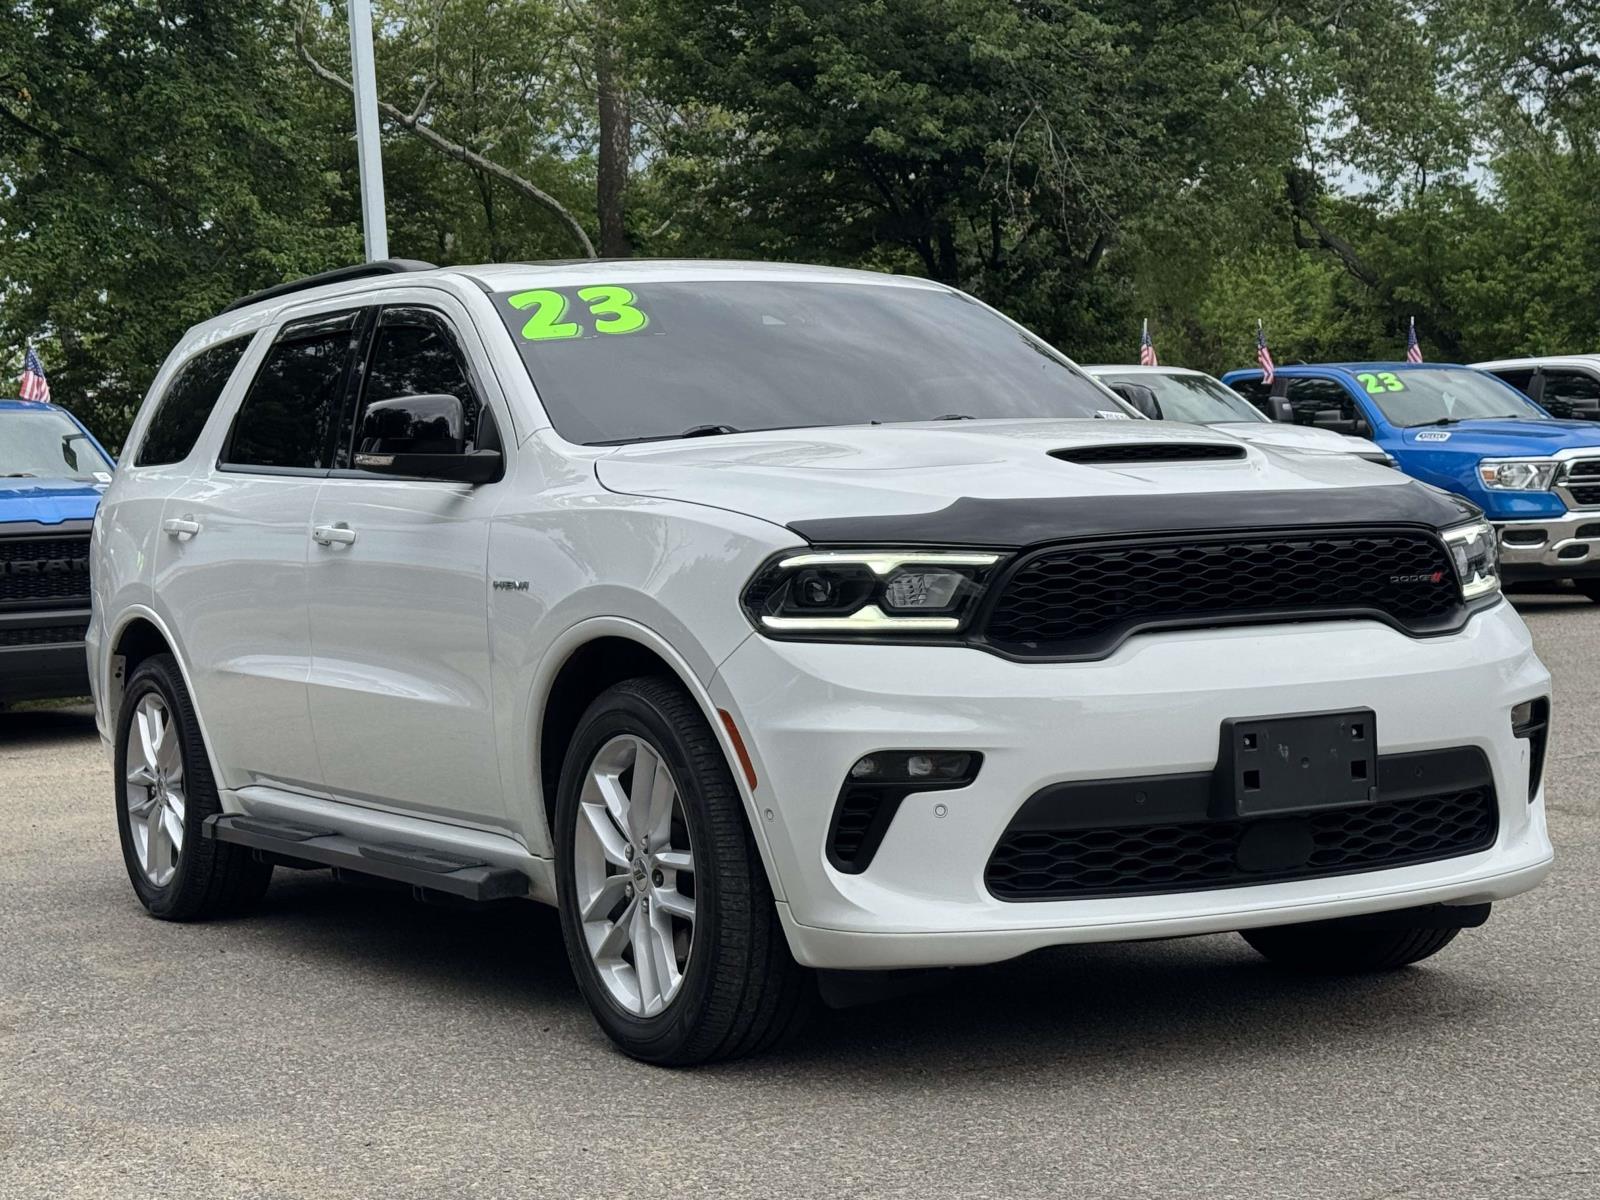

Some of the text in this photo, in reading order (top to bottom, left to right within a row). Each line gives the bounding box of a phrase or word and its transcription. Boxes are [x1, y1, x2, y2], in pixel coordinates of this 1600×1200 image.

[508, 284, 649, 341] 23
[1357, 372, 1405, 394] 23
[1390, 574, 1432, 584] DODGE
